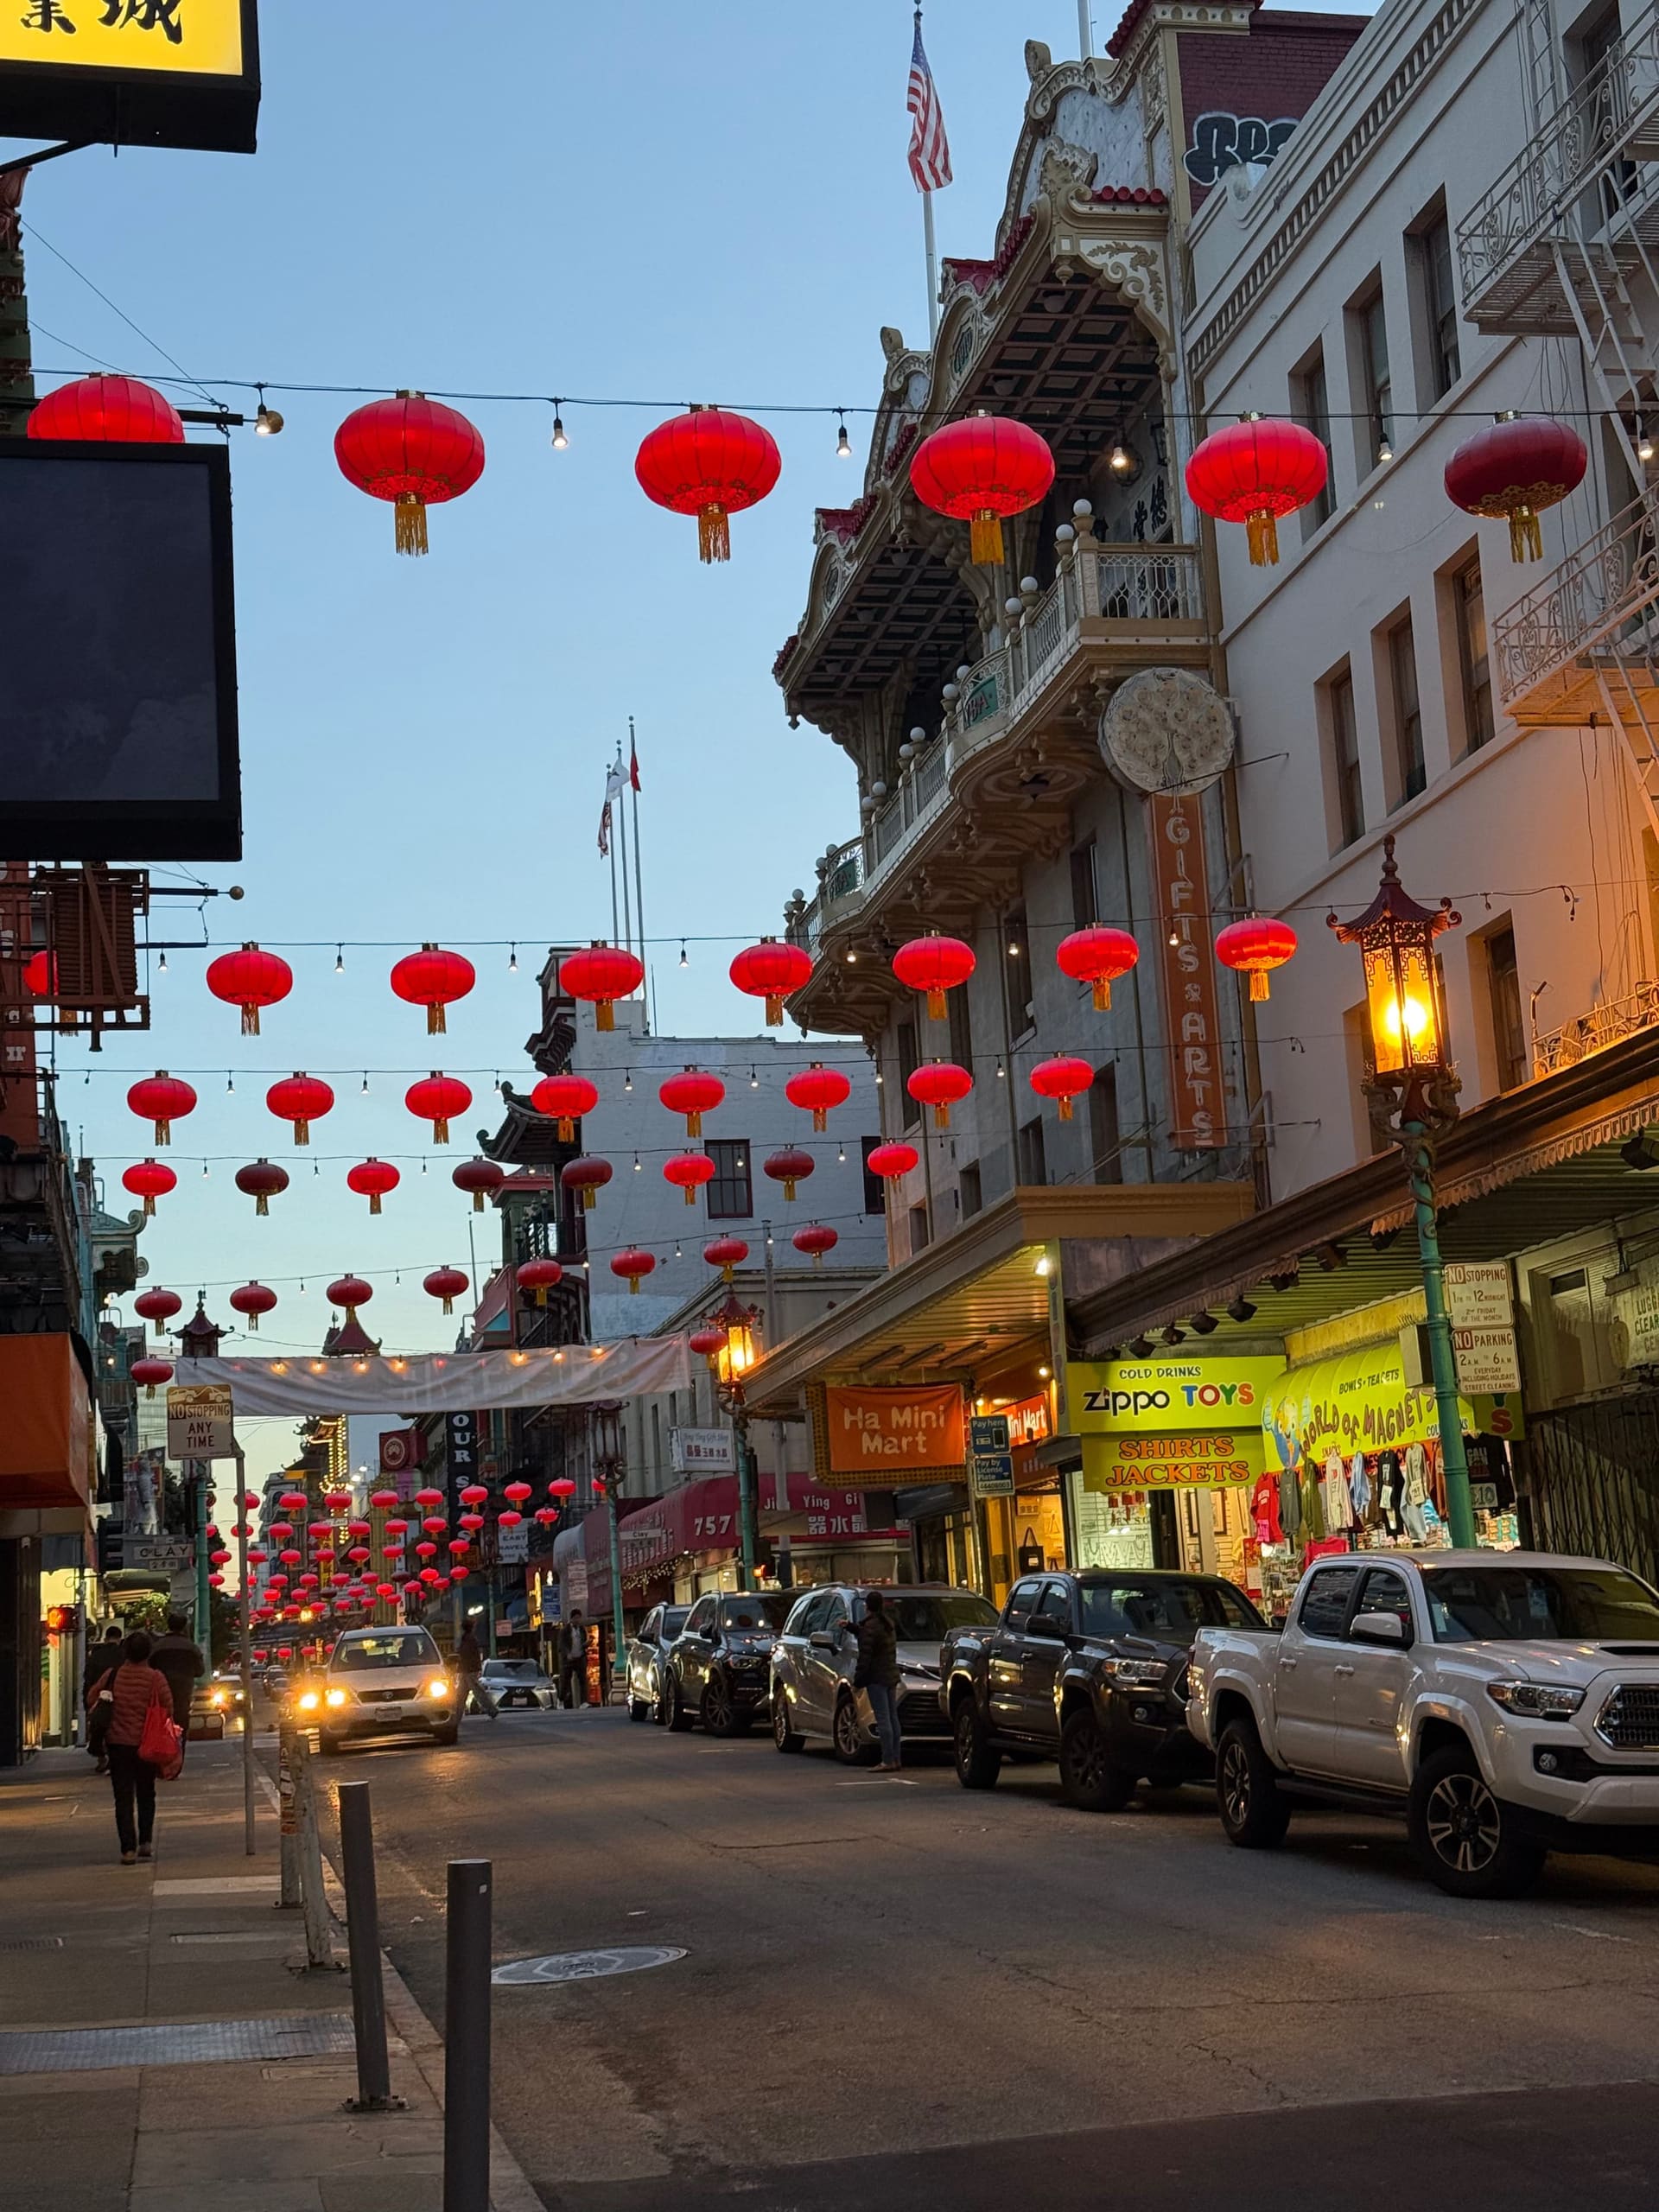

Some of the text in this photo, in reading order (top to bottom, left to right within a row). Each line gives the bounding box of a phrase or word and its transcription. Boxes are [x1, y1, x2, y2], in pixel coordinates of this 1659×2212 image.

[1165, 816, 1214, 1140] GIFTS & ARTS
[1448, 1267, 1506, 1283] NO STOPPING
[1636, 1294, 1659, 1316] LUGG
[1454, 1332, 1513, 1349] NO PARKING
[1119, 1365, 1202, 1380] COLD DRINKS
[1180, 1382, 1254, 1408] TOYS
[169, 1403, 230, 1419] NO STOPPING
[843, 1405, 945, 1430] Ha Mini
[188, 1421, 213, 1434] ANY
[972, 1420, 987, 1428] Pay
[186, 1434, 215, 1449] TIME
[861, 1431, 927, 1456] Mart
[1119, 1436, 1235, 1460] SHIRTS
[1106, 1460, 1250, 1487] JACKETS
[802, 1495, 830, 1511] Ying
[694, 1515, 731, 1536] 757
[139, 1545, 188, 1557] CLAY
